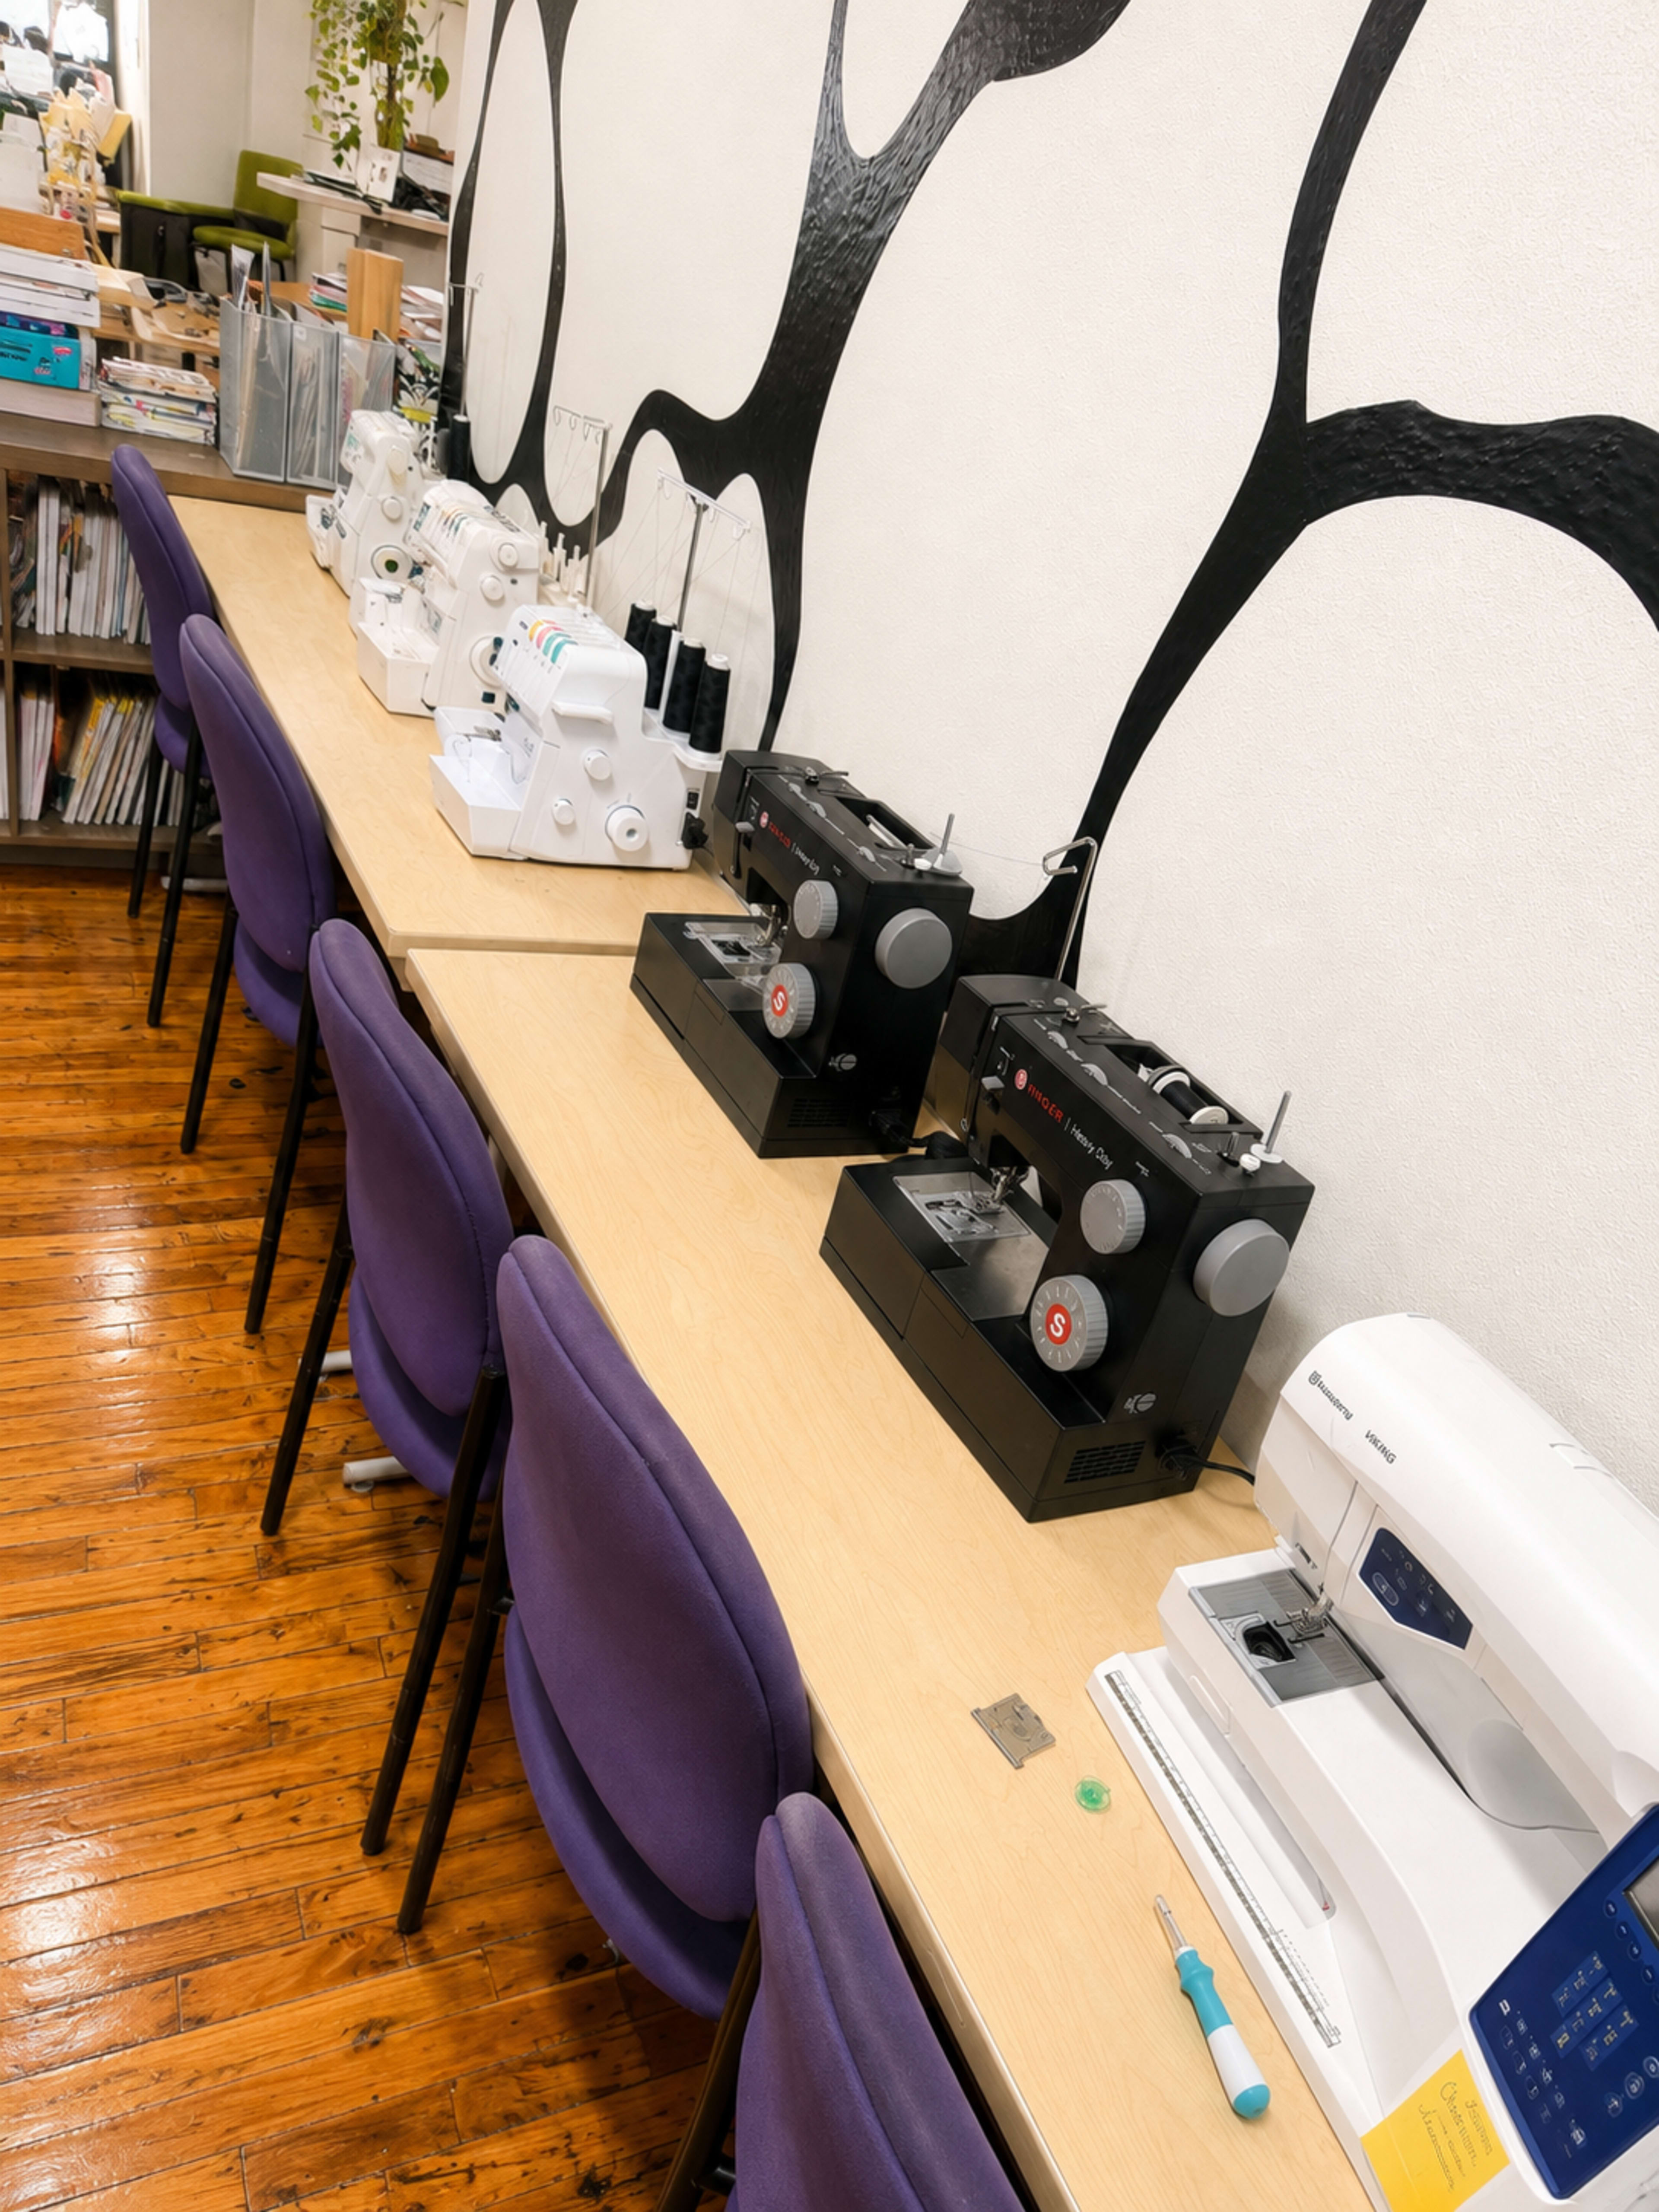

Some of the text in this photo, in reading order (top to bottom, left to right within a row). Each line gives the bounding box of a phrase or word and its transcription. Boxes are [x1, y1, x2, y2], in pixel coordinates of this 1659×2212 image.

[773, 991, 785, 1011] S
[1050, 1313, 1065, 1338] S
[1365, 1430, 1397, 1464] VIKING
